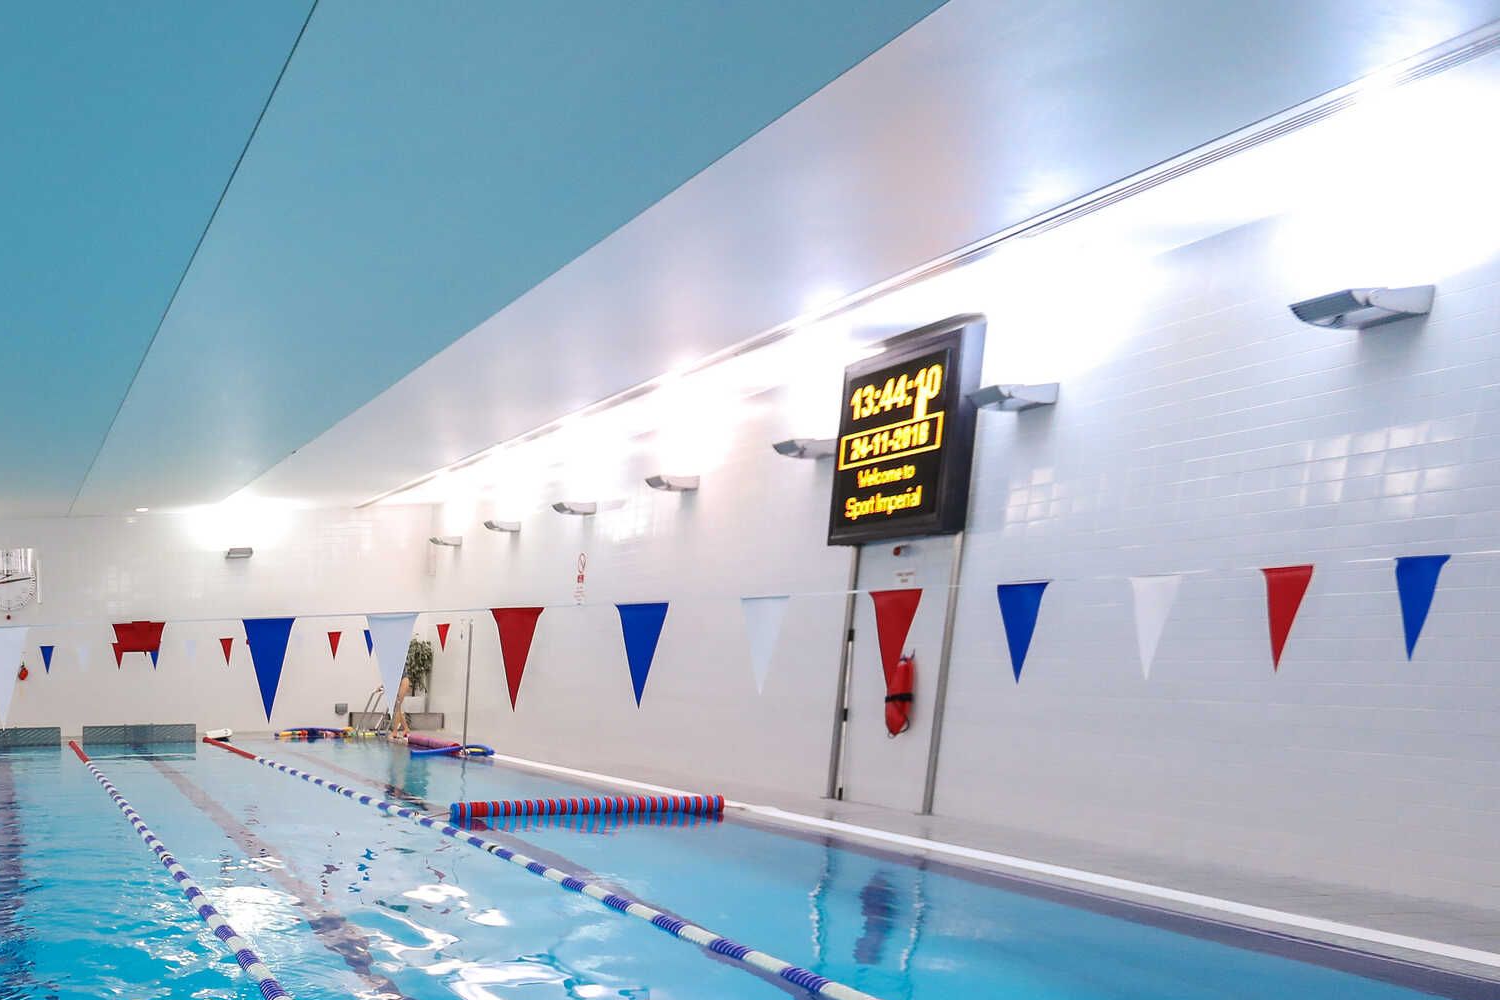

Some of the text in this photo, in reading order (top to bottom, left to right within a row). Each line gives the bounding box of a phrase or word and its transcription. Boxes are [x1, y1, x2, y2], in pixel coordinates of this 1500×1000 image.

[850, 363, 943, 420] 13:44:10
[857, 464, 916, 488] Welcome to
[845, 485, 922, 520] Sport Imperial
